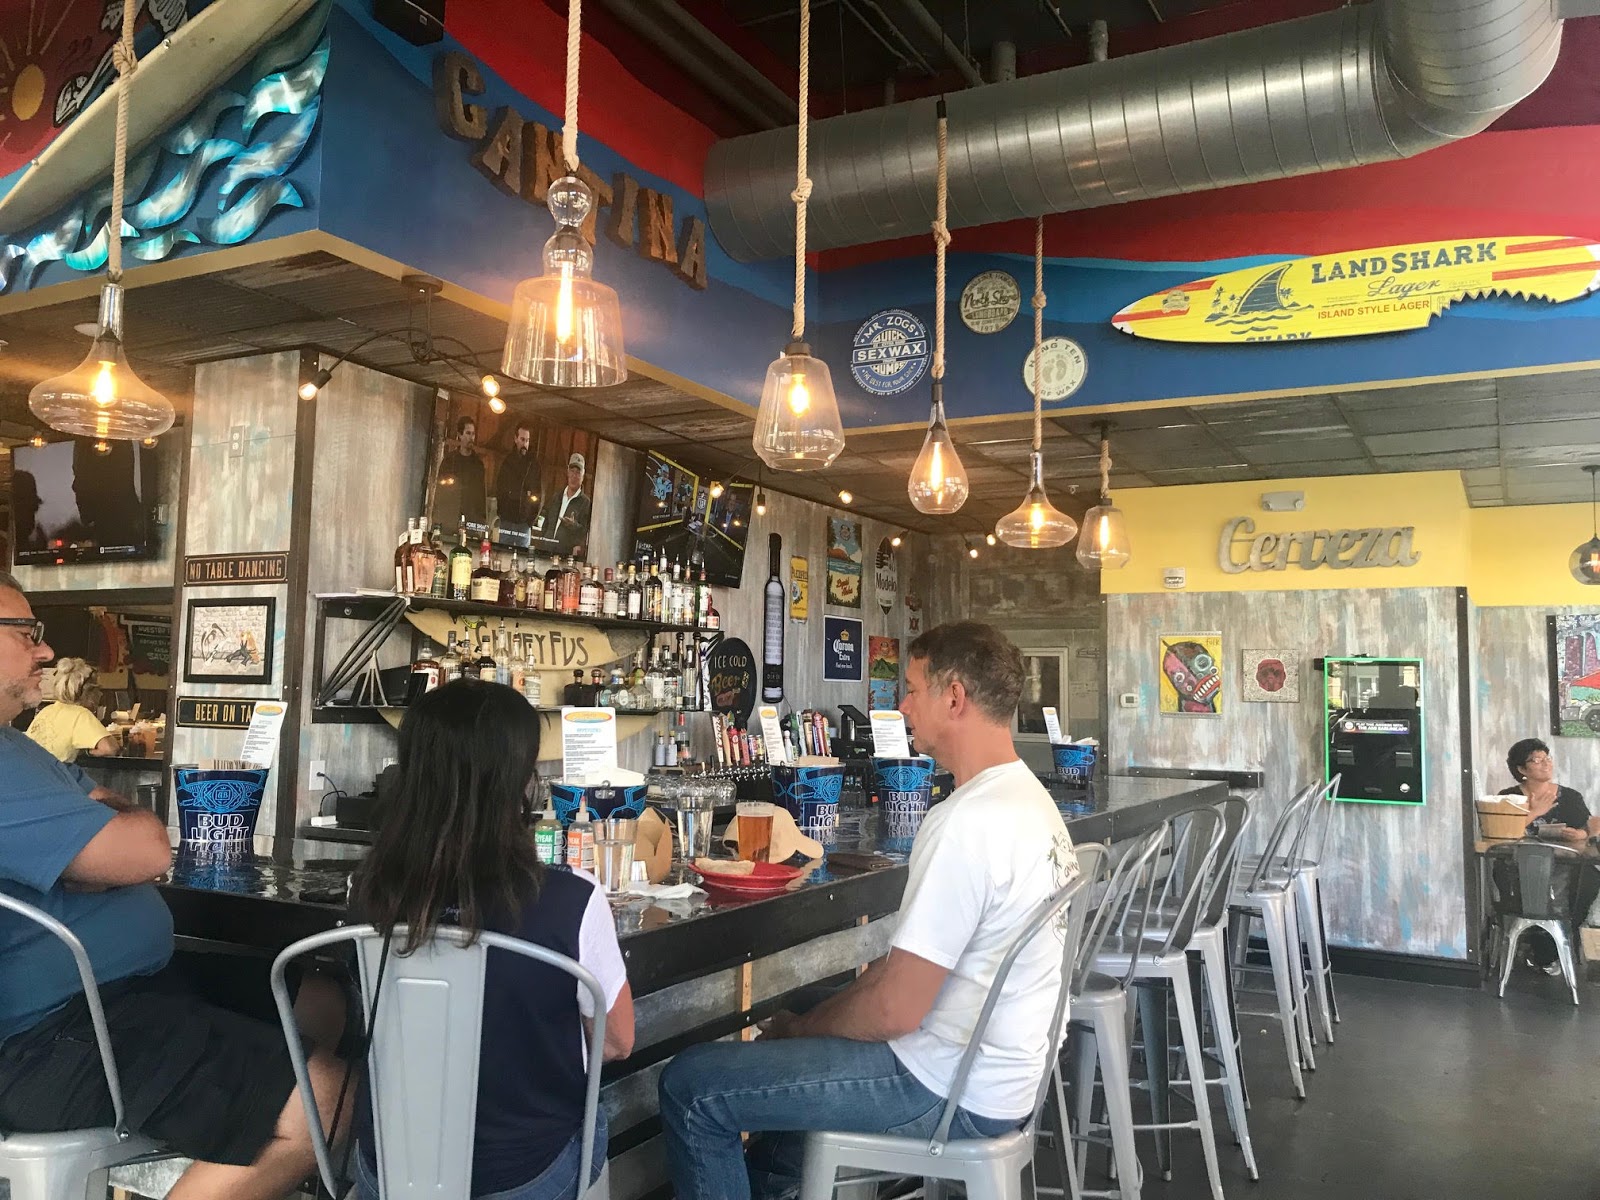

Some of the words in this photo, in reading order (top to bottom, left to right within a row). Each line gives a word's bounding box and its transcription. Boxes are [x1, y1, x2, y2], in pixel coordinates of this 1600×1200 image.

[1367, 275, 1441, 300] Lager
[1318, 307, 1355, 319] ISLAND
[1357, 304, 1390, 316] STYLE
[1393, 300, 1430, 311] LAGER
[886, 316, 916, 333] ZOGS
[857, 343, 922, 361] SEXWAX
[1028, 342, 1058, 368] HNG
[1063, 343, 1081, 364] TEN
[1056, 379, 1077, 396] WAX
[1218, 516, 1422, 574] Cerveza
[189, 563, 201, 579] NO
[205, 561, 234, 579] TABLE
[238, 559, 282, 578] DANCING
[875, 572, 897, 592] Modelo
[832, 638, 854, 654] Corona
[714, 655, 726, 668] ICE
[729, 655, 747, 668] COLD
[838, 651, 850, 661] Extra
[195, 703, 218, 722] BEER
[222, 704, 236, 722] ON
[240, 705, 254, 723] TA
[1057, 766, 1080, 775] BUD
[888, 791, 922, 803] BUD
[885, 801, 926, 813] LIGHT
[197, 813, 245, 828] BUD
[809, 815, 836, 828] LIG
[190, 826, 250, 841] LIGHT
